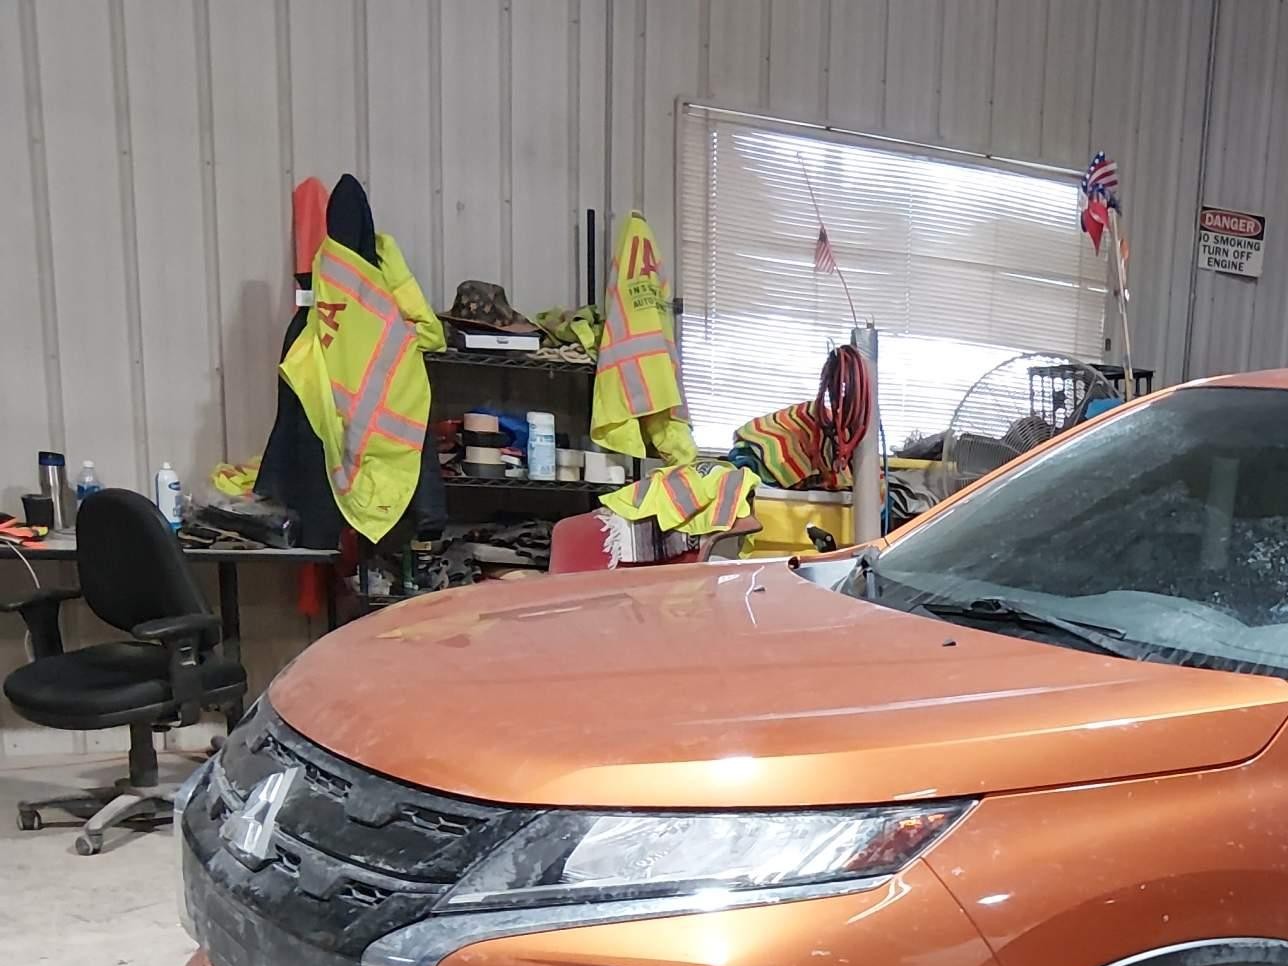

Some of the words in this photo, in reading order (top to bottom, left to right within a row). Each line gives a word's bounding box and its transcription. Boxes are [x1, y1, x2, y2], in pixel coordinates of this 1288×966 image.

[1205, 213, 1255, 233] DANGER
[1213, 235, 1261, 252] SMOKING
[1203, 245, 1229, 258] TURN
[1233, 250, 1253, 262] OFF
[1207, 257, 1245, 272] ENGINE
